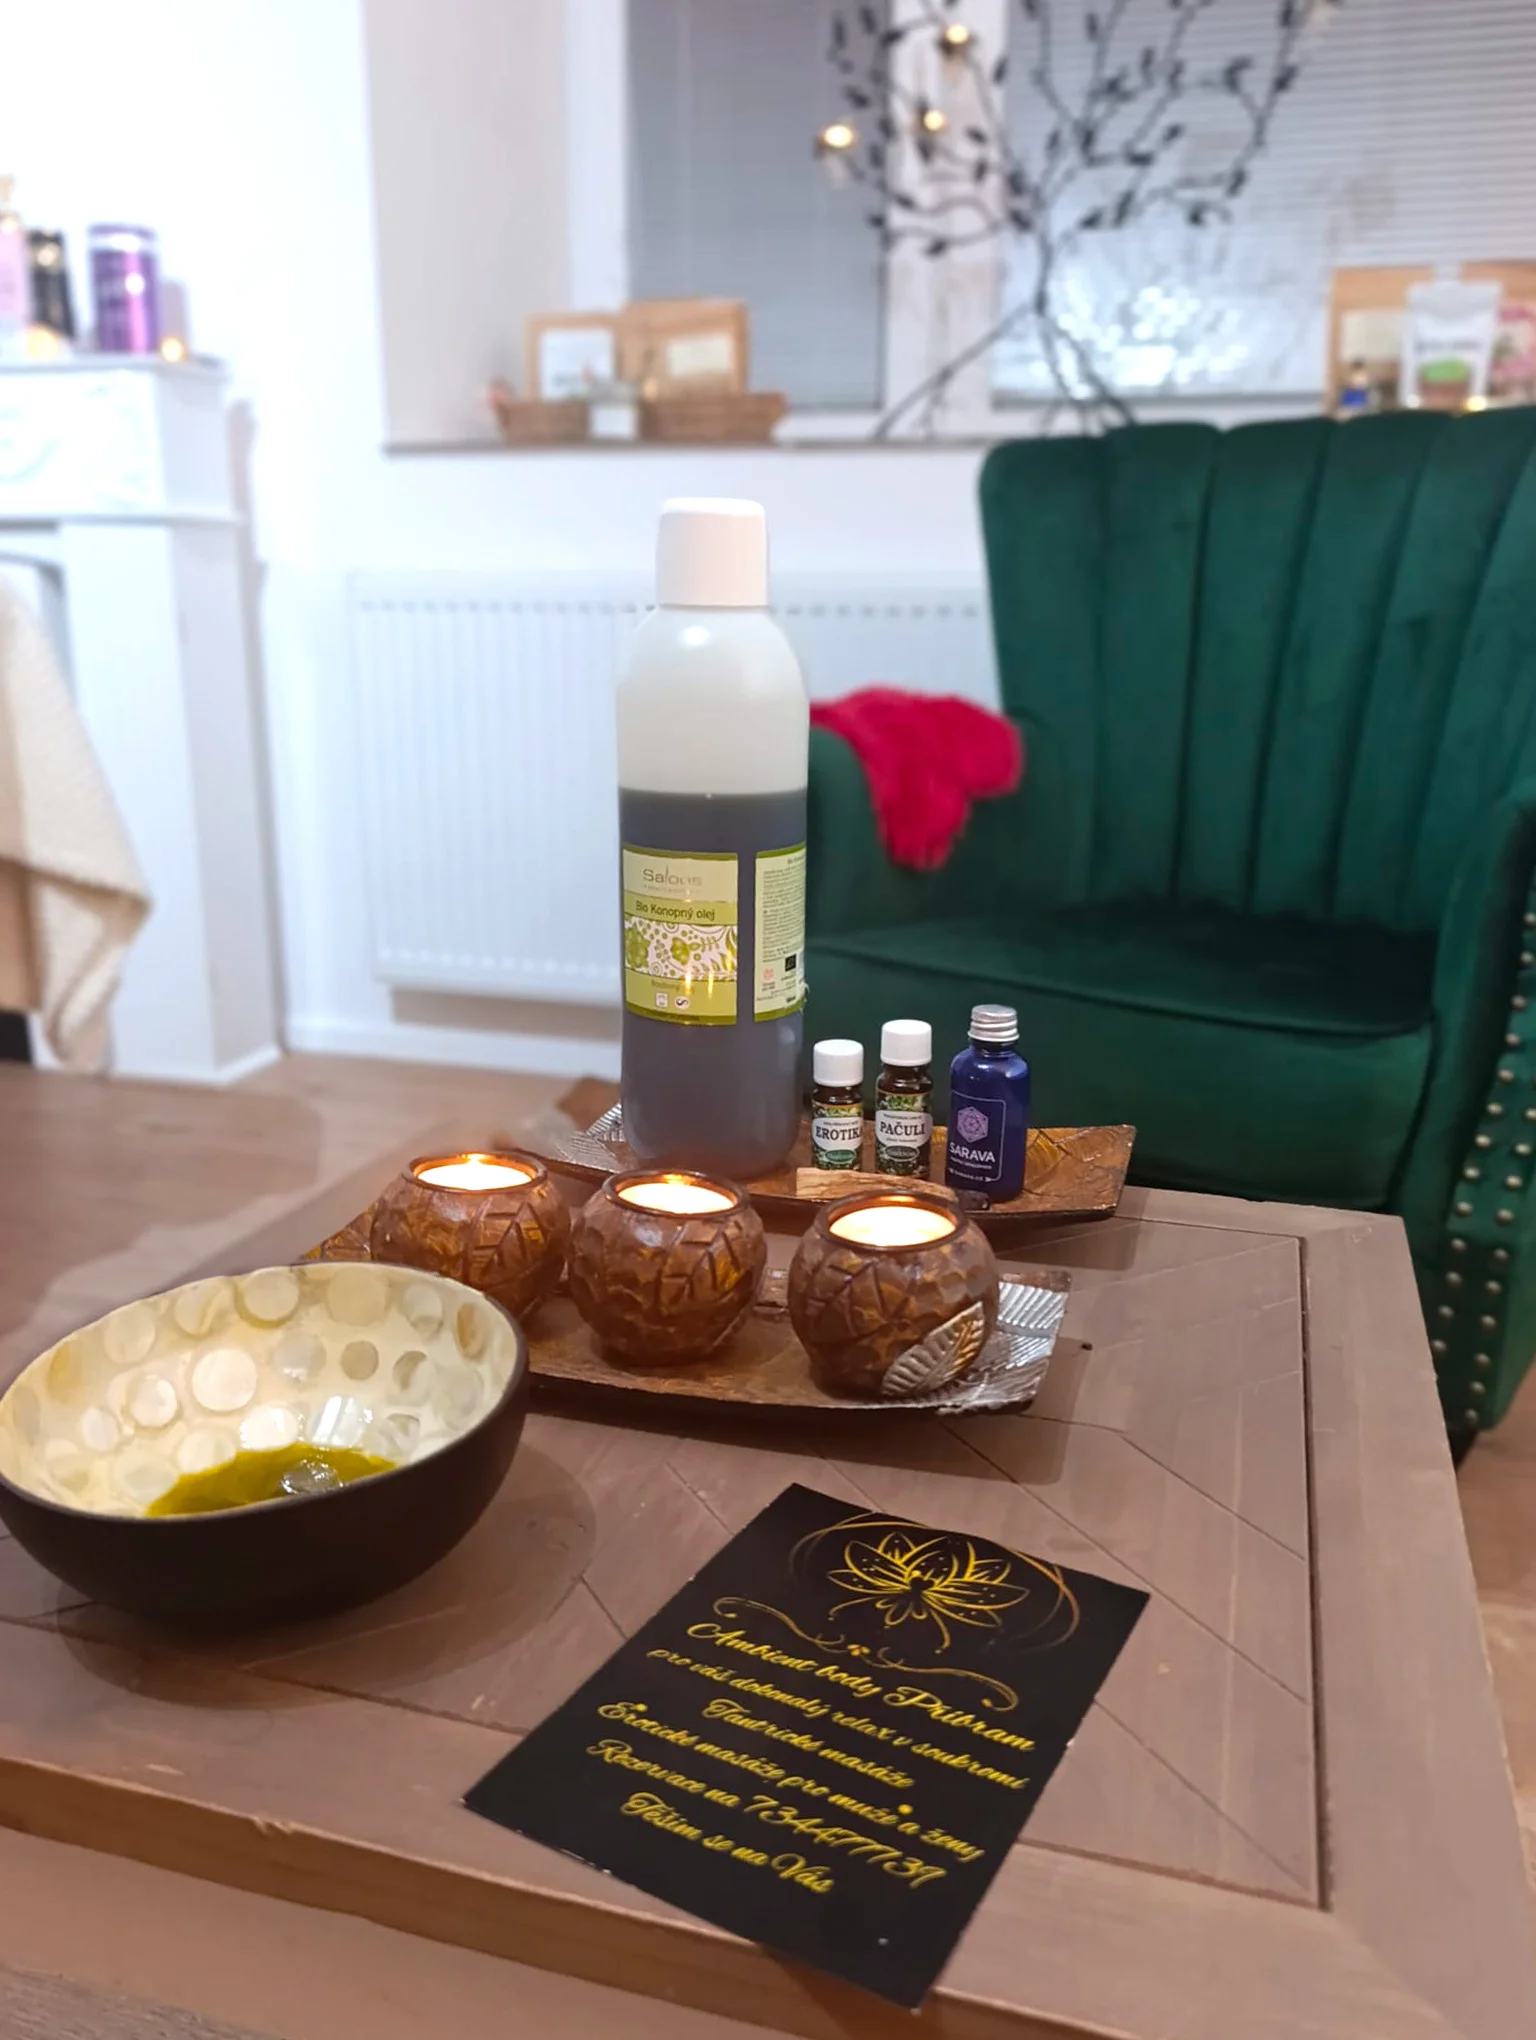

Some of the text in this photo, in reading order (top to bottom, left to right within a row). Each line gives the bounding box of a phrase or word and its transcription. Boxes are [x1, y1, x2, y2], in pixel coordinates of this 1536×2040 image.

[650, 904, 693, 920] Konopný
[696, 908, 715, 922] olej
[880, 1121, 925, 1136] PAČULI
[949, 1141, 996, 1163] SARAVA
[646, 1649, 692, 1666] pro
[832, 1711, 896, 1740] relax
[892, 1736, 914, 1746] v
[687, 1623, 1035, 1752] Ambient body Příbram
[586, 1739, 706, 1795] Rezervace
[703, 1788, 742, 1808] na
[694, 1742, 786, 1779] masáže
[776, 1776, 831, 1797] pro
[827, 1793, 900, 1826] muže
[897, 1821, 921, 1836] a
[919, 1828, 986, 1863] ženy
[818, 1748, 915, 1789] masáže
[620, 1791, 836, 1894] Těším se na Vás
